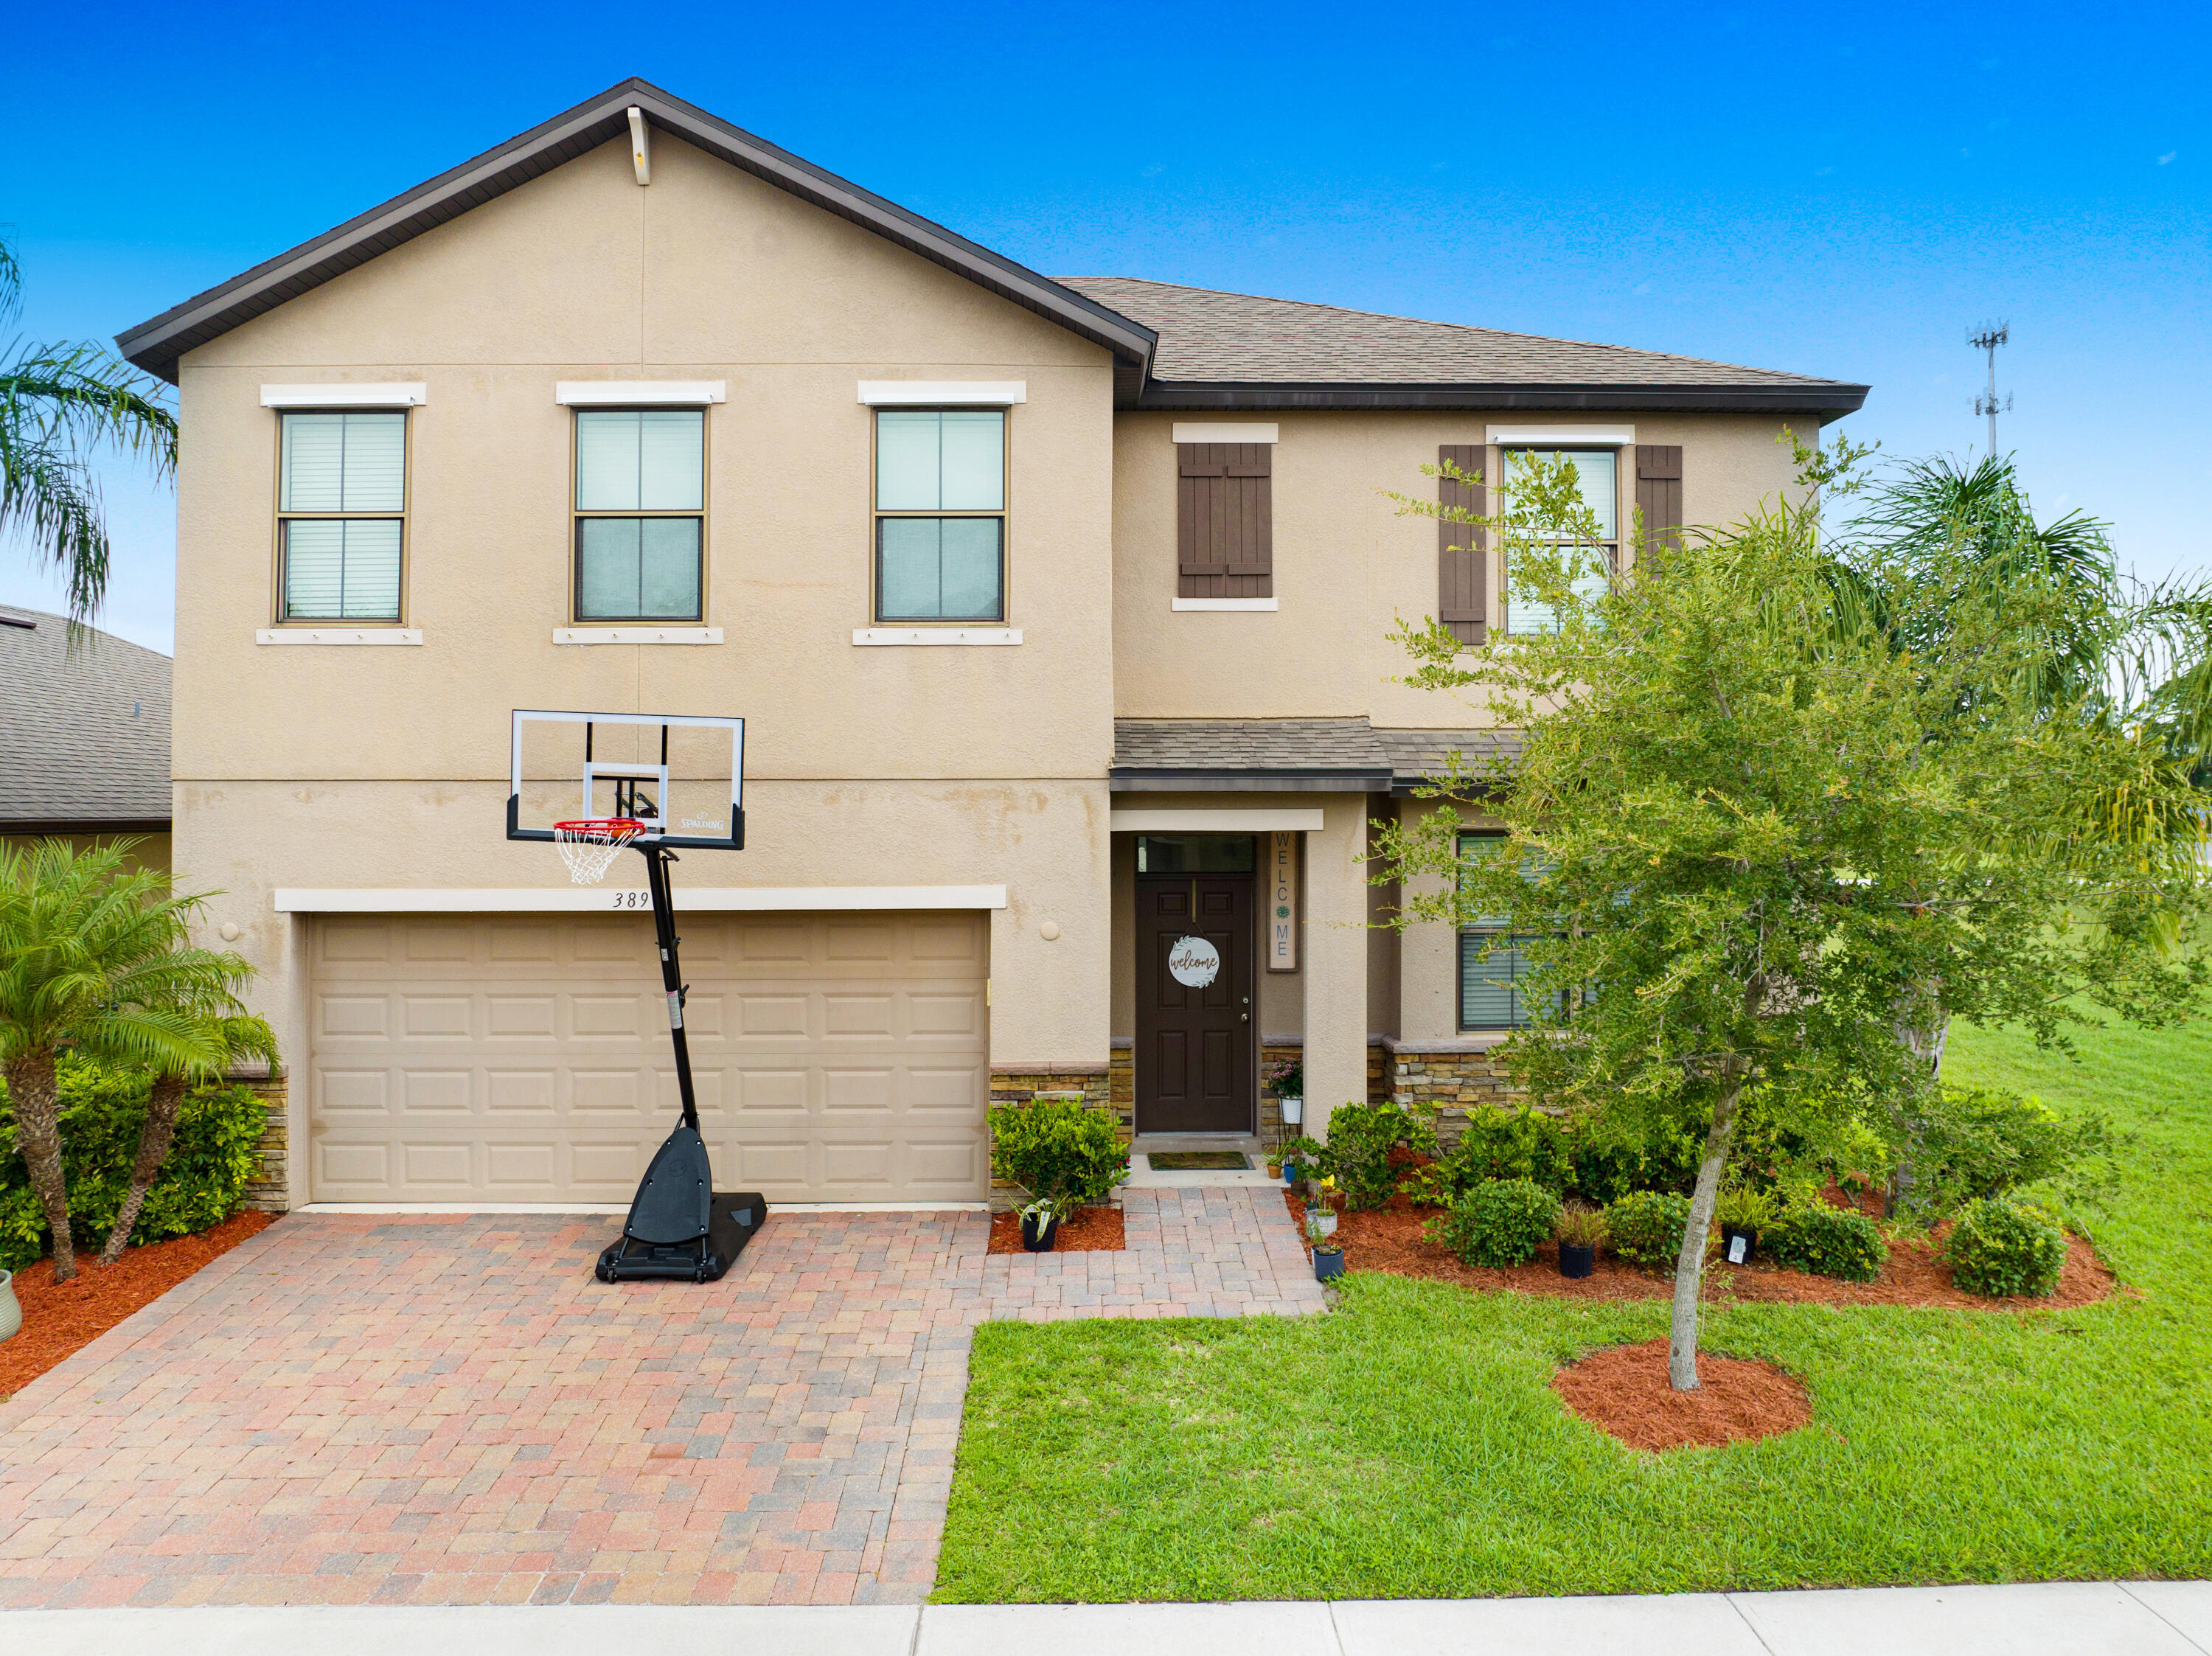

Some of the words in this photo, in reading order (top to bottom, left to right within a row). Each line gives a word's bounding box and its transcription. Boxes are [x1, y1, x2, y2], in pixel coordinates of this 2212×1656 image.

[681, 818, 725, 830] SPALDING
[613, 892, 649, 908] 389
[1170, 950, 1218, 971] welcome
